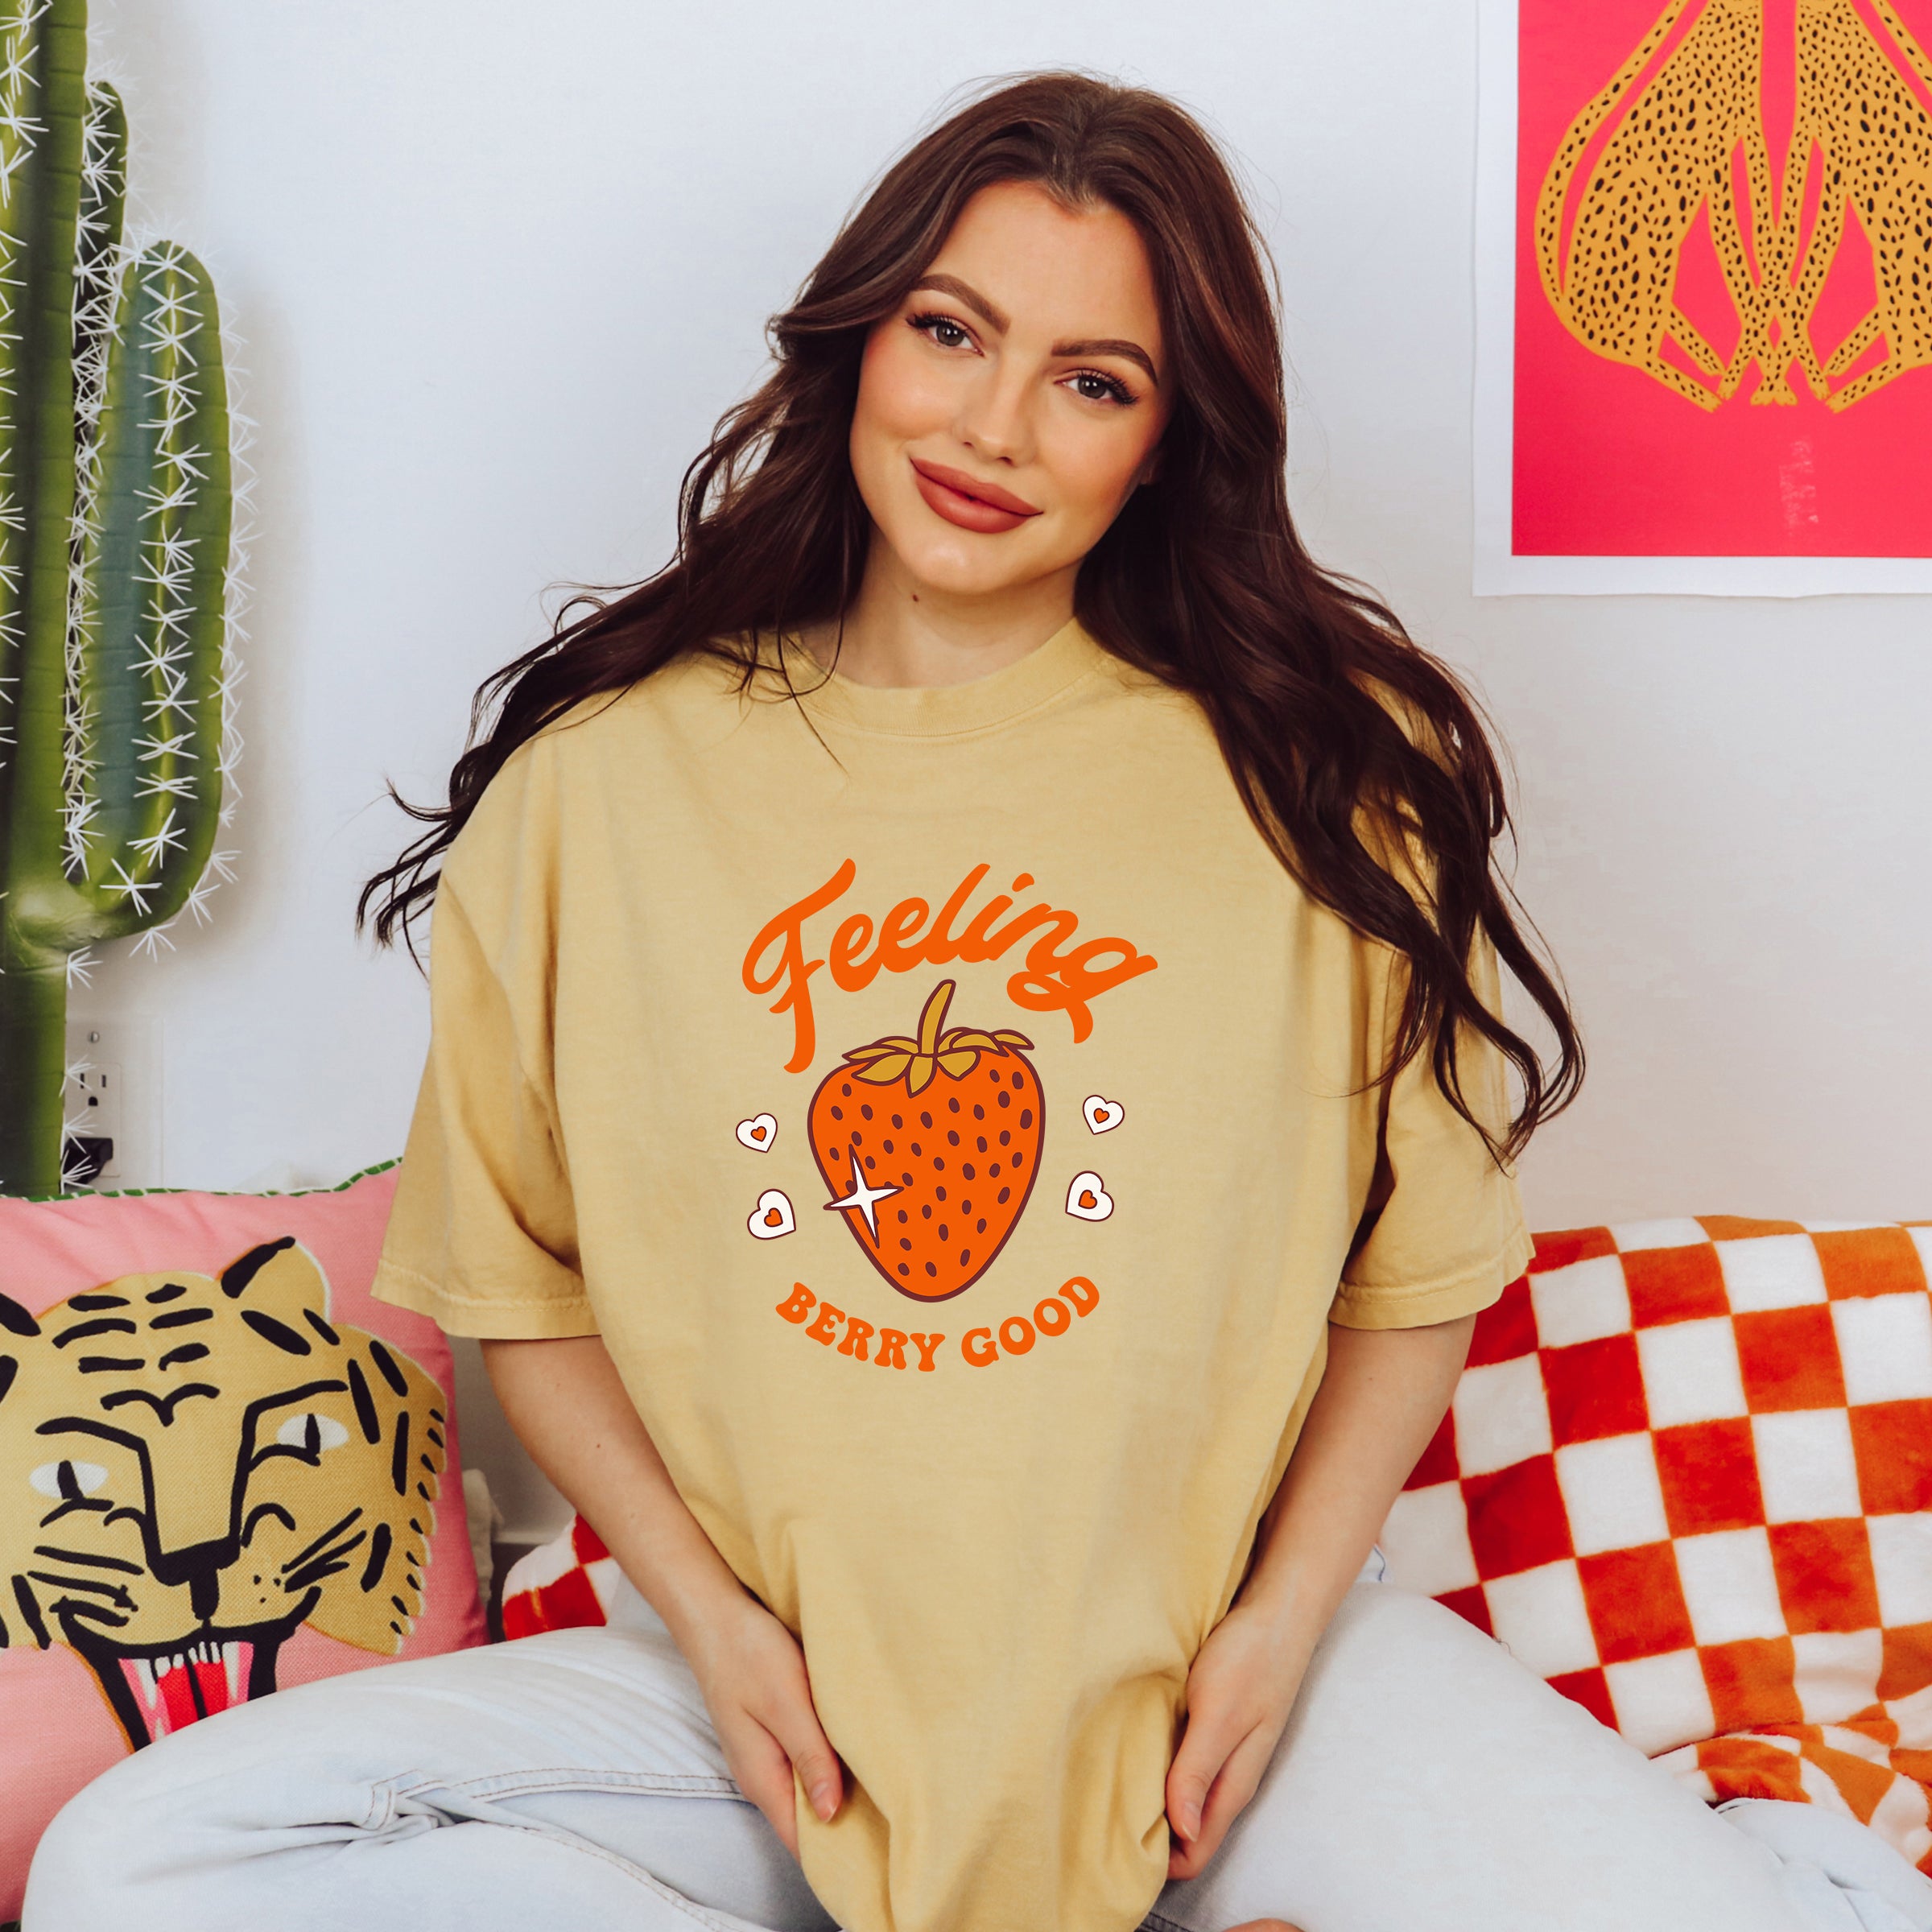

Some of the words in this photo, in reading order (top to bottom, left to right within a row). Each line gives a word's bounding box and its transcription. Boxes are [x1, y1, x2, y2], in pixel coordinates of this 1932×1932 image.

[741, 858, 1158, 1074] Feeling
[775, 1282, 946, 1373] BERRY
[961, 1276, 1100, 1368] GOOD
